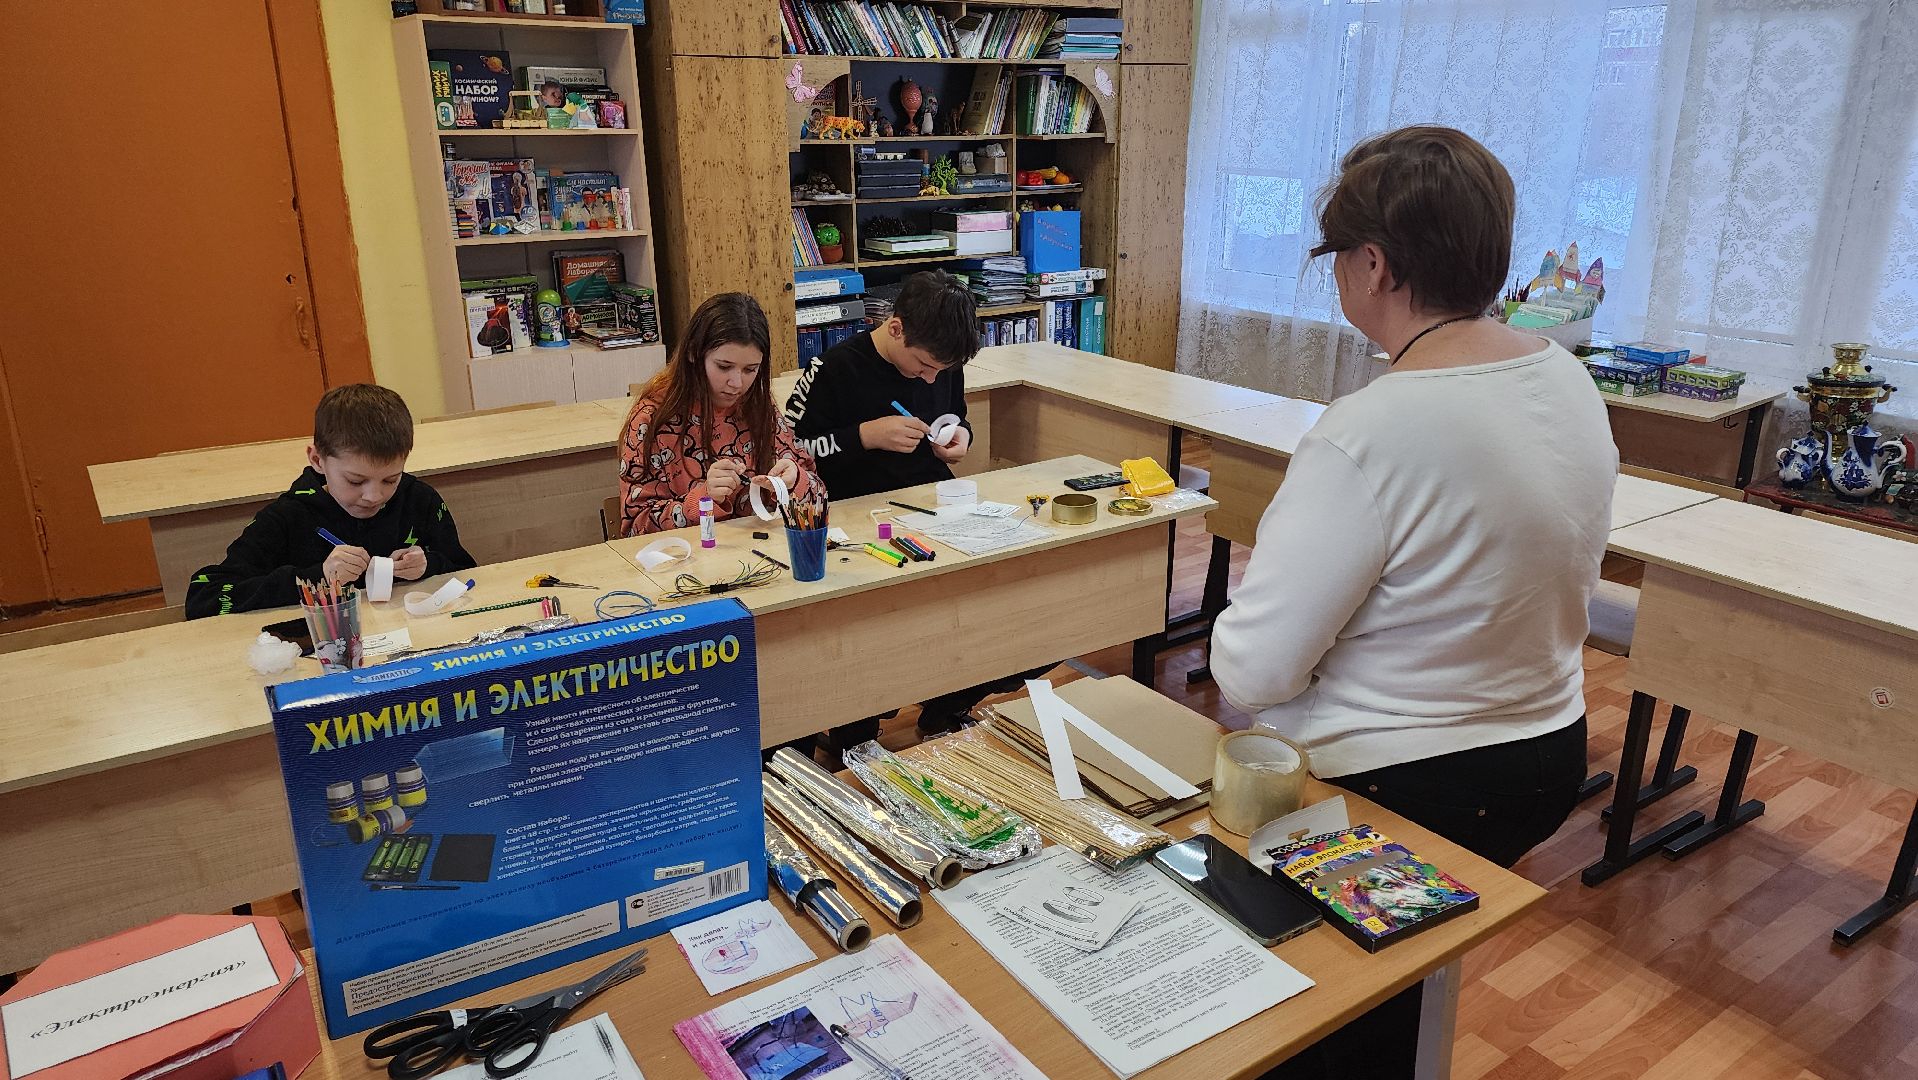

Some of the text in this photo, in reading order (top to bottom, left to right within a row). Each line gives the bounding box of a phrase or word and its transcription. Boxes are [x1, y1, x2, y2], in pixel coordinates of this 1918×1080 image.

[431, 69, 443, 98] ХИМИИ
[441, 70, 451, 98] ТАЙНЫ
[455, 85, 499, 96] НАБОР
[431, 612, 687, 673] ХИМИЯ И ЭЛЕКТРИЧЕСТВО
[303, 632, 741, 755] ХИМИЯ И ЭЛЕКТРИЧЕСТВО
[369, 667, 413, 683] FANTASTIC
[524, 682, 700, 729] Узнай много интересного об электричестве
[525, 729, 533, 737] и
[533, 728, 539, 736] о
[540, 717, 585, 734] свойствах
[584, 707, 633, 724] химических
[526, 732, 559, 747] Сделай
[559, 722, 604, 740] батарейки
[604, 721, 614, 729] из
[615, 716, 635, 726] соли
[642, 704, 685, 721] различных
[527, 742, 558, 757] измерь
[559, 740, 570, 749] их
[571, 727, 622, 746] напряжение
[629, 718, 660, 732] заставь
[661, 709, 701, 725] светодиод
[529, 758, 567, 775] Разложи
[568, 755, 588, 767] воду
[588, 752, 599, 761] на
[600, 742, 639, 759] кислород
[681, 725, 708, 738] сделай
[507, 779, 525, 790] при
[613, 750, 643, 764] медную
[511, 782, 550, 798] металлы
[505, 812, 571, 835] Состав набора:
[1286, 839, 1375, 875] НАБОР ФЛОМАСТЕРОВ
[30, 959, 247, 1040] «Электроэнергия»
